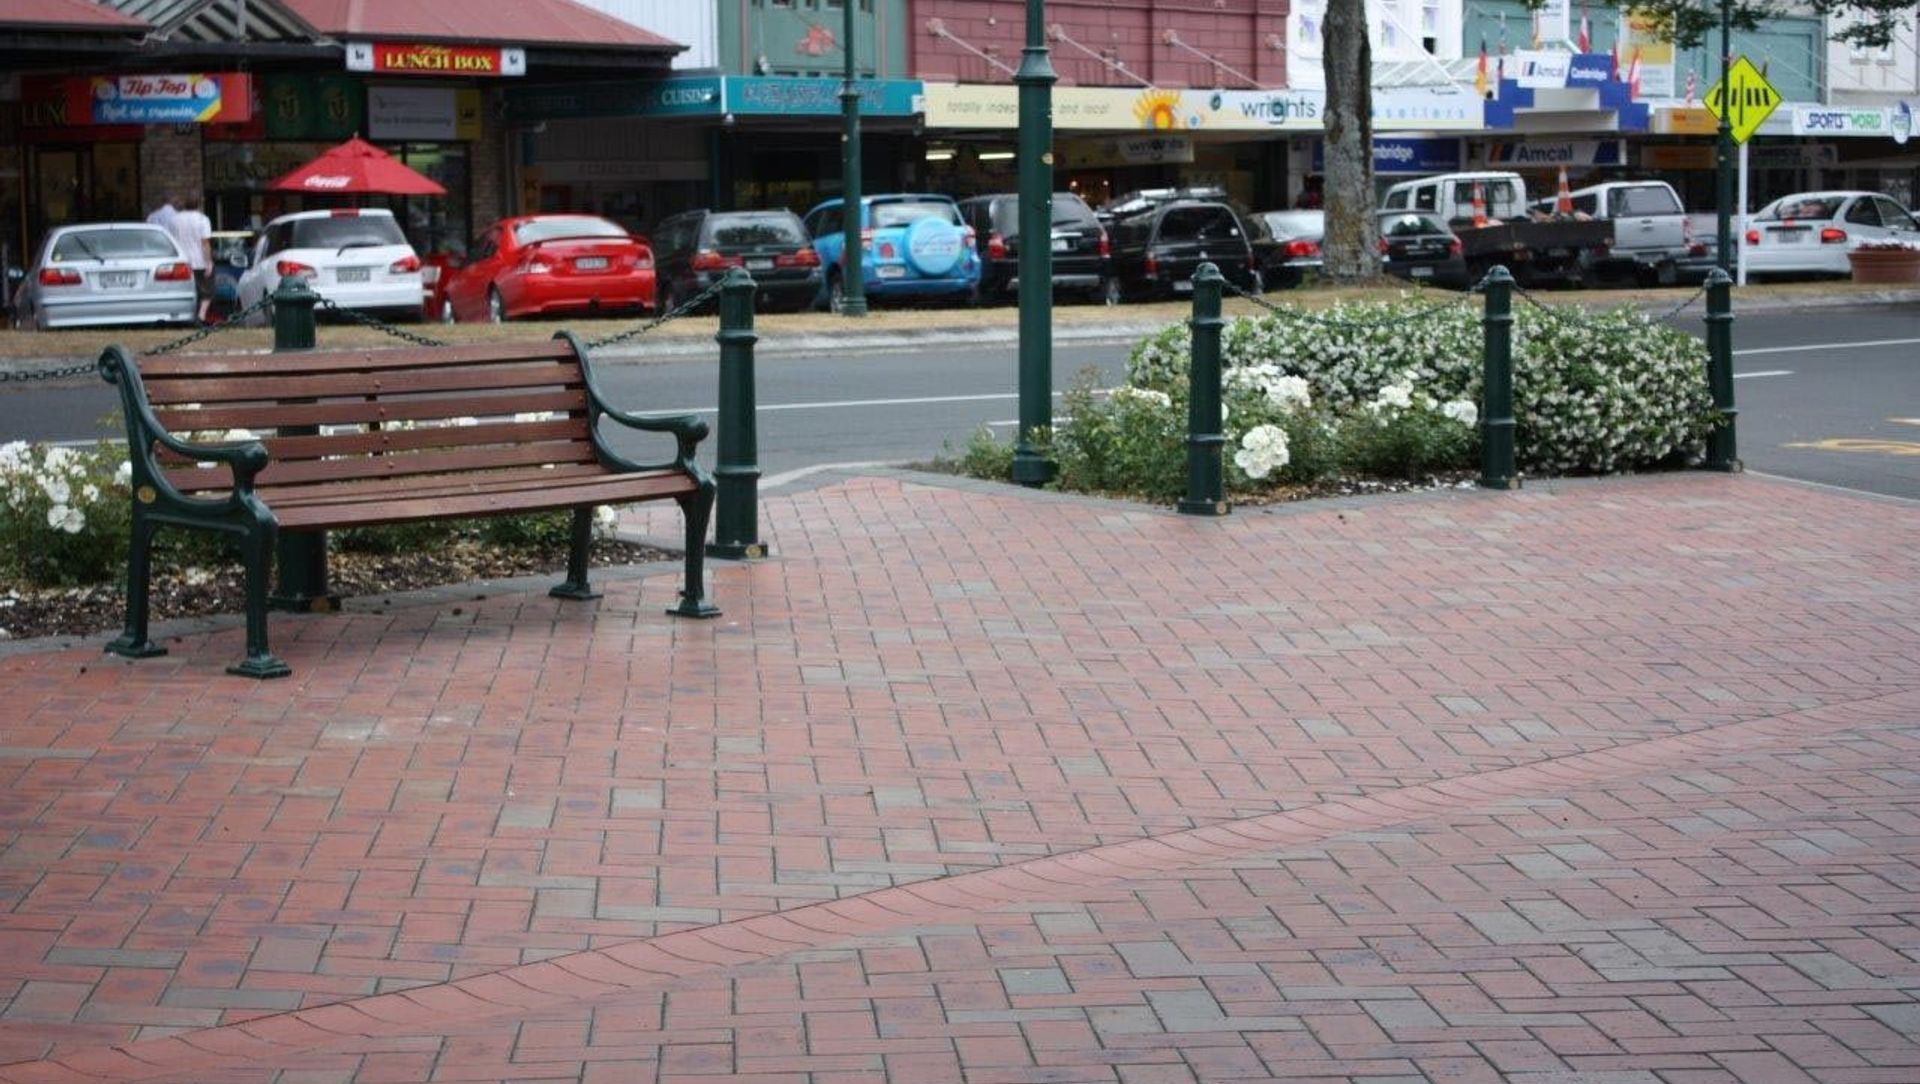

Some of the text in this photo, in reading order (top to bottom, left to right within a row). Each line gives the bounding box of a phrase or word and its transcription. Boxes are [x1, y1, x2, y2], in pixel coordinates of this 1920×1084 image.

[385, 52, 492, 71] LUNCH BOX
[124, 79, 187, 96] Tip Top
[1241, 96, 1316, 125] wrights
[1373, 144, 1414, 161] mbridge
[1516, 143, 1573, 162] Amcal
